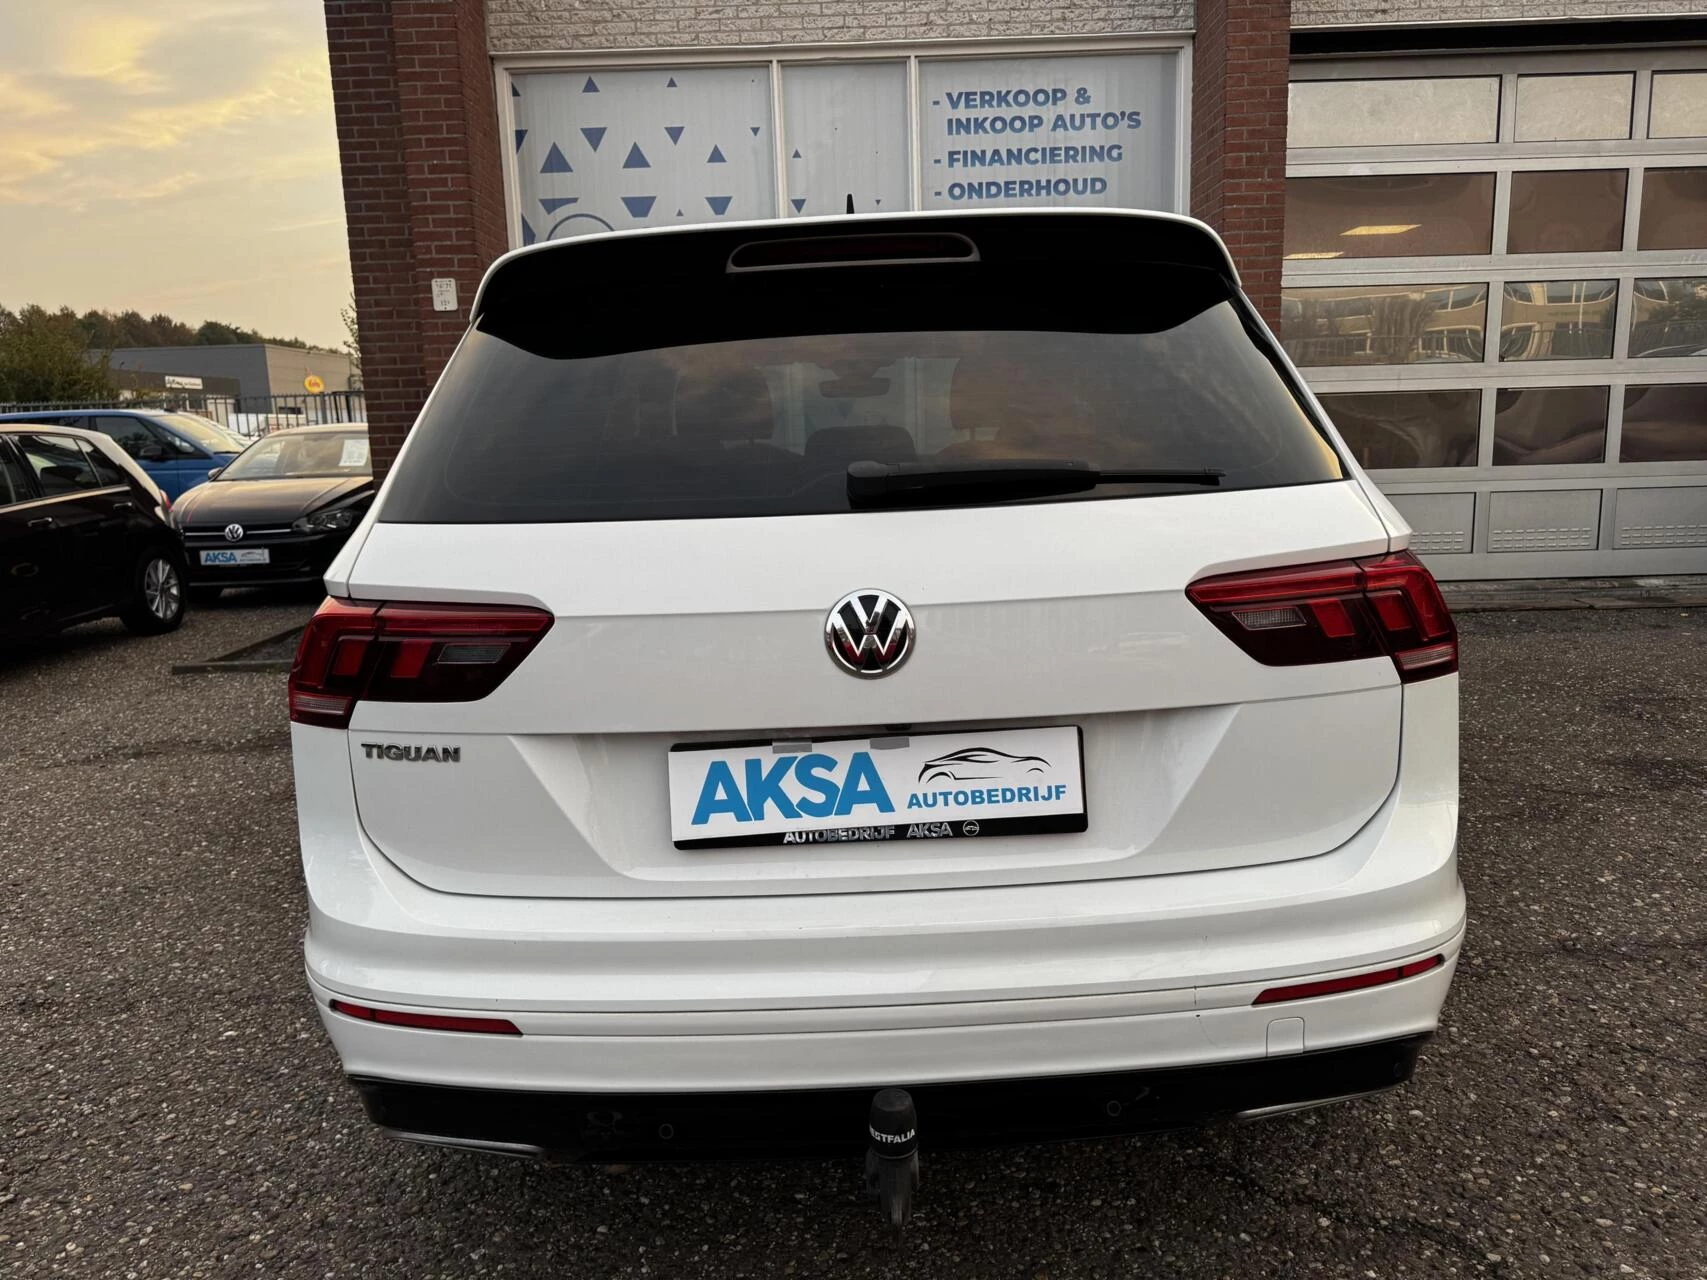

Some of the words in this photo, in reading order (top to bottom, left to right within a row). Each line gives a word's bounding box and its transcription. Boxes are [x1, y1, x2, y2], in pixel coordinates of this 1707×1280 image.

[945, 88, 1067, 109] VERKOOP
[1074, 87, 1091, 105] &
[947, 115, 1044, 136] INKOOP
[1051, 111, 1141, 132] AUTO'S
[947, 144, 1123, 168] FINANCIERING
[947, 177, 1108, 200] ONDERHOUD
[204, 551, 238, 563] AKSA
[361, 743, 461, 762] TIGUAN
[691, 751, 896, 826] AKSA
[907, 784, 1067, 809] AUTOBEDRIJF
[783, 826, 895, 844] AUTOBEDRIJF
[906, 822, 953, 838] AKSA
